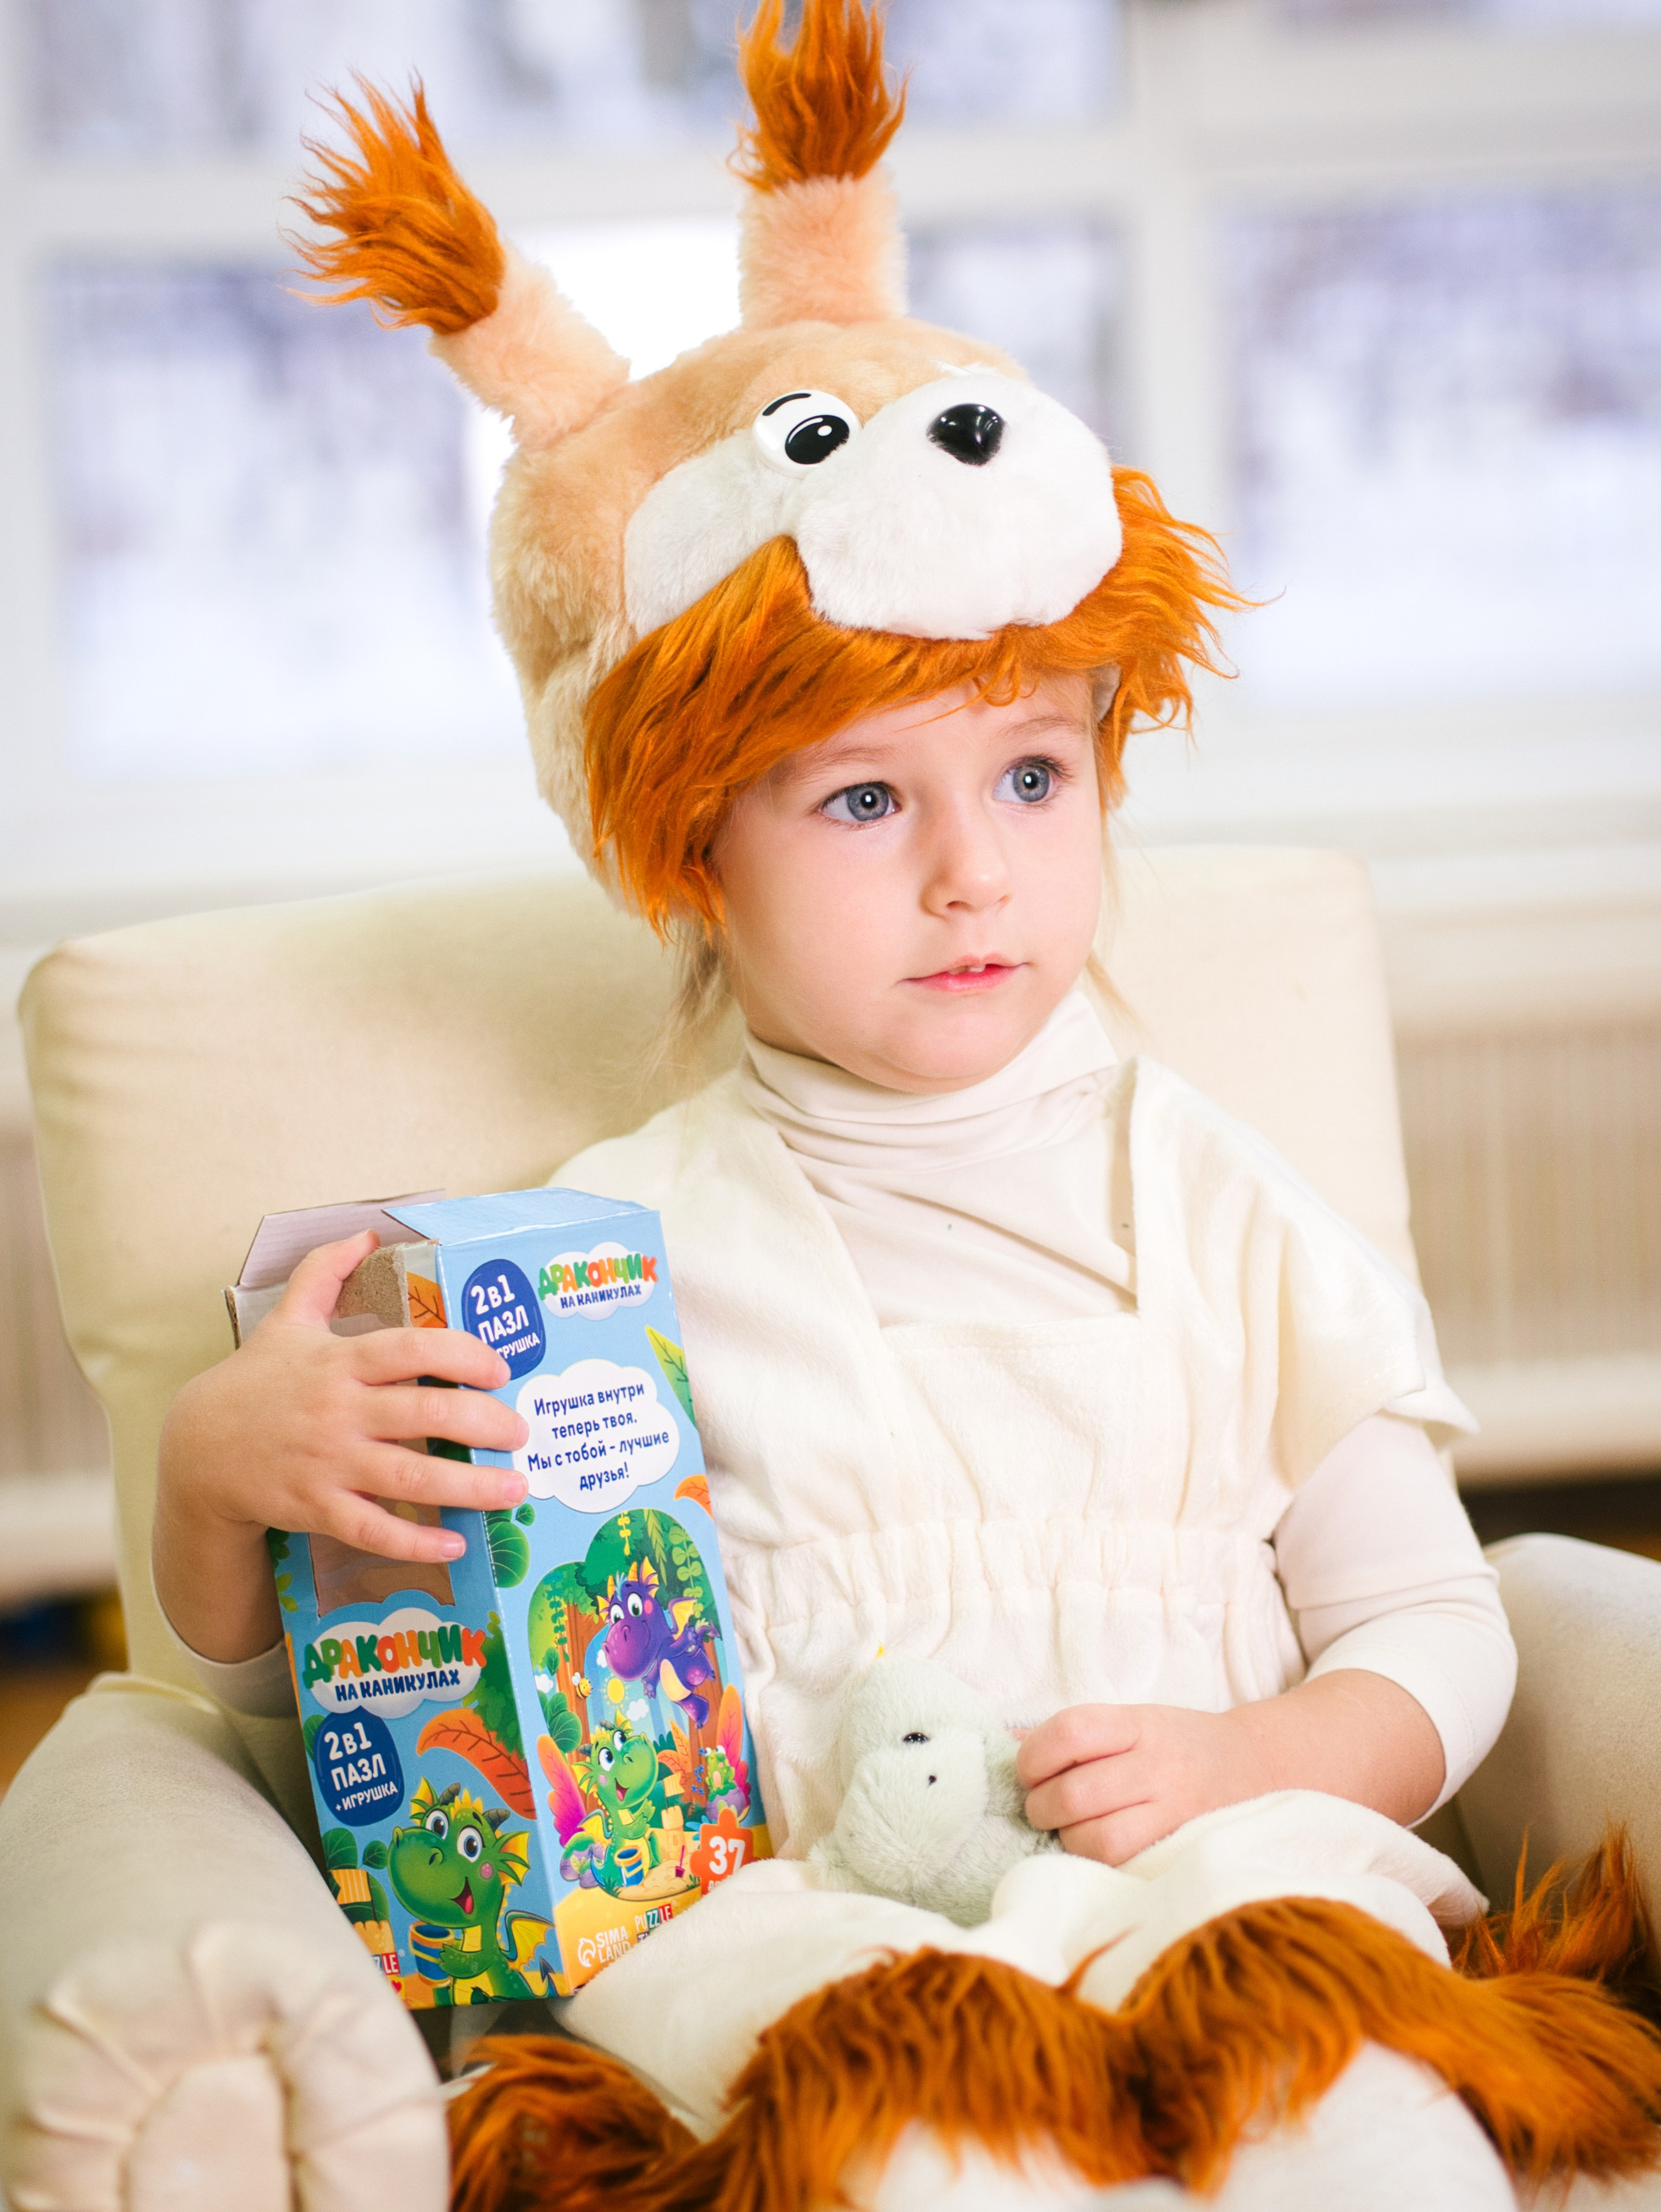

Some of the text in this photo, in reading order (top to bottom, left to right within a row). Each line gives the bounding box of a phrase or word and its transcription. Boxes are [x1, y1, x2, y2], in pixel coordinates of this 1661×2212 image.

[538, 1253, 659, 1300] ДРАКОНЧИК
[560, 1284, 642, 1309] НА КАНИКУЛАХ
[478, 1305, 529, 1344] ПАЗЛ
[496, 1332, 540, 1359] ГРУШКА
[534, 1383, 645, 1417] Игрушка внутри
[552, 1413, 637, 1439] теперь твоя.
[527, 1454, 552, 1472] Мы
[555, 1453, 563, 1466] с
[565, 1440, 607, 1463] тобой
[620, 1431, 669, 1454] лучшие
[579, 1462, 629, 1492] друзья!
[302, 1624, 487, 1689] ДРАКОНЧИК
[335, 1669, 460, 1701] НА КАНИКУЛАХ
[331, 1753, 385, 1790] ПАЗЛ
[709, 1836, 746, 1876] 37
[596, 1926, 629, 1949] SIMA
[598, 1941, 631, 1963] LAND
